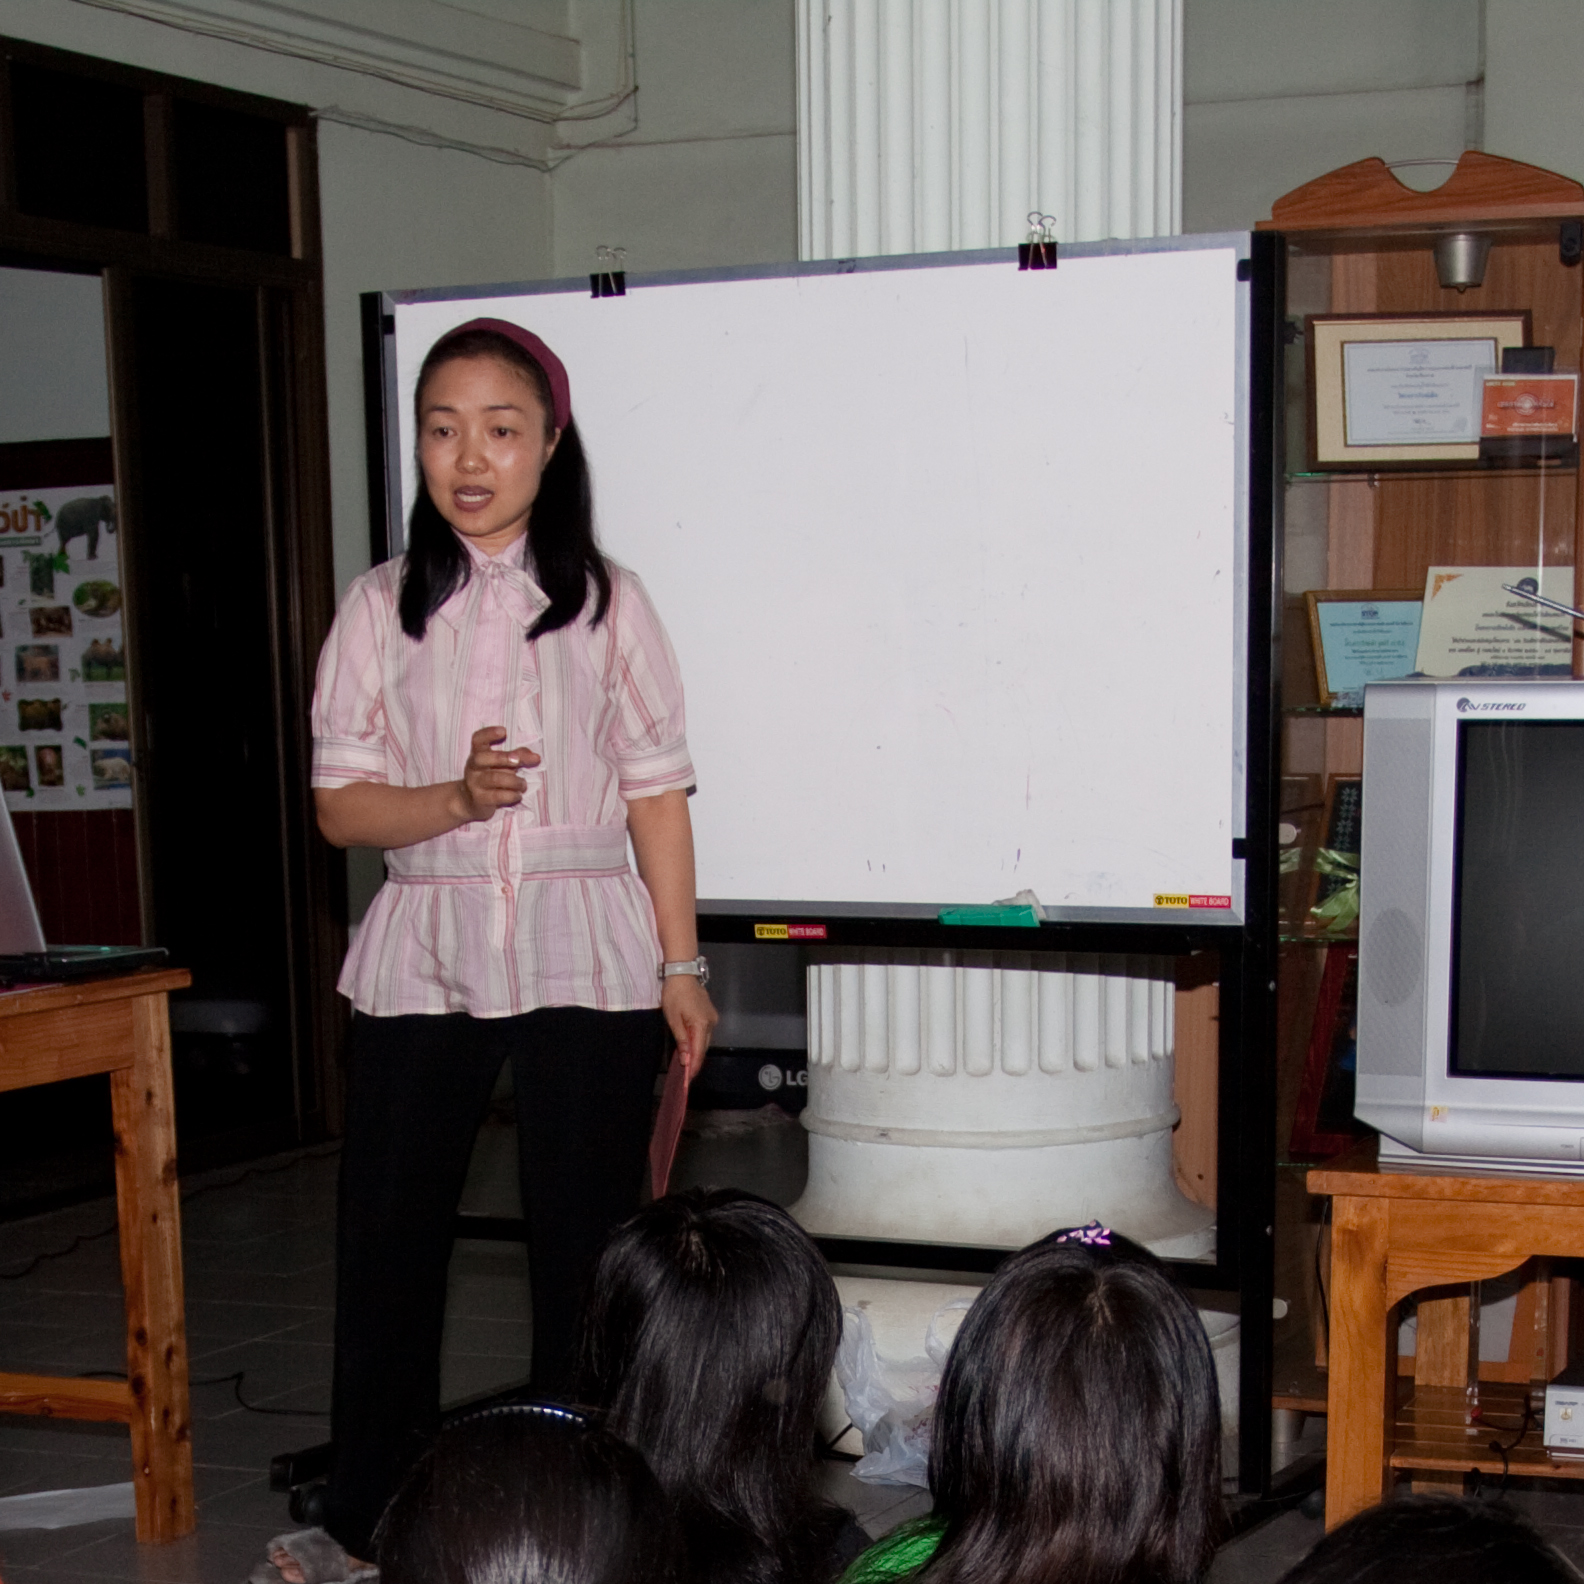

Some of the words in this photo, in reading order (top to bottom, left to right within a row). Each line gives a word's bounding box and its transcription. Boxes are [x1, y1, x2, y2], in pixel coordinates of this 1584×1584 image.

[1480, 702, 1527, 711] STEREO
[1164, 896, 1188, 905] TOTO
[766, 927, 787, 935] TOTO
[786, 1070, 808, 1087] LG
